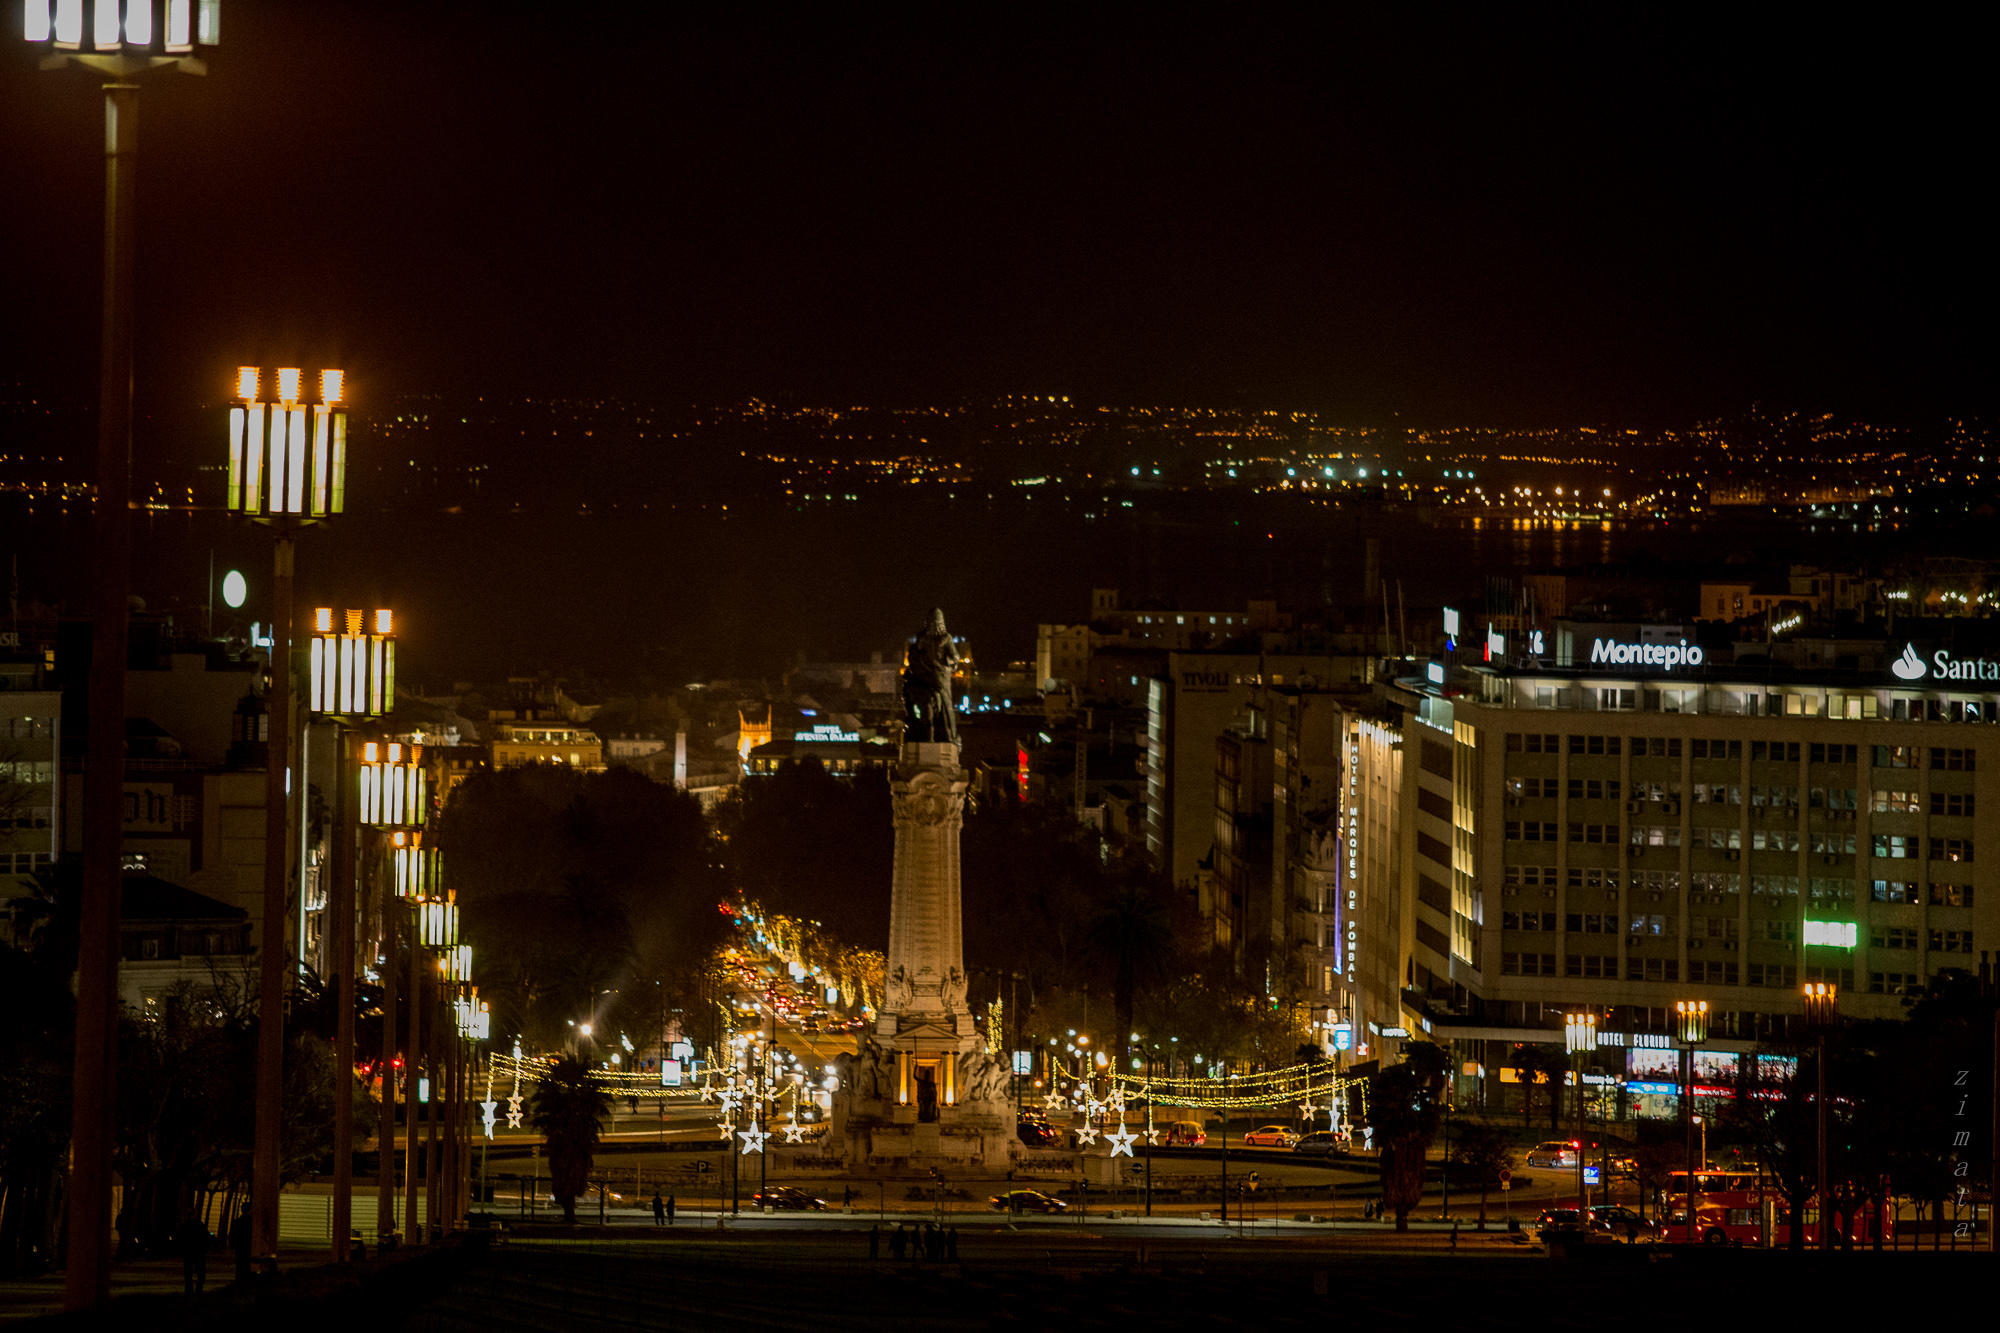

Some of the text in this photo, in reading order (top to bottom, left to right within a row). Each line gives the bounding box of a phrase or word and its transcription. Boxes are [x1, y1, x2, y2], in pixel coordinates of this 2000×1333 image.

[1591, 638, 1703, 671] Montepio
[1933, 649, 2000, 680] Santa
[1182, 671, 1229, 686] TIVOLI
[1350, 745, 1358, 796] HOTEL
[1348, 889, 1356, 910] DE
[1347, 920, 1356, 983] POMBAL
[1597, 1032, 1670, 1049] HOTEL FLORIDA
